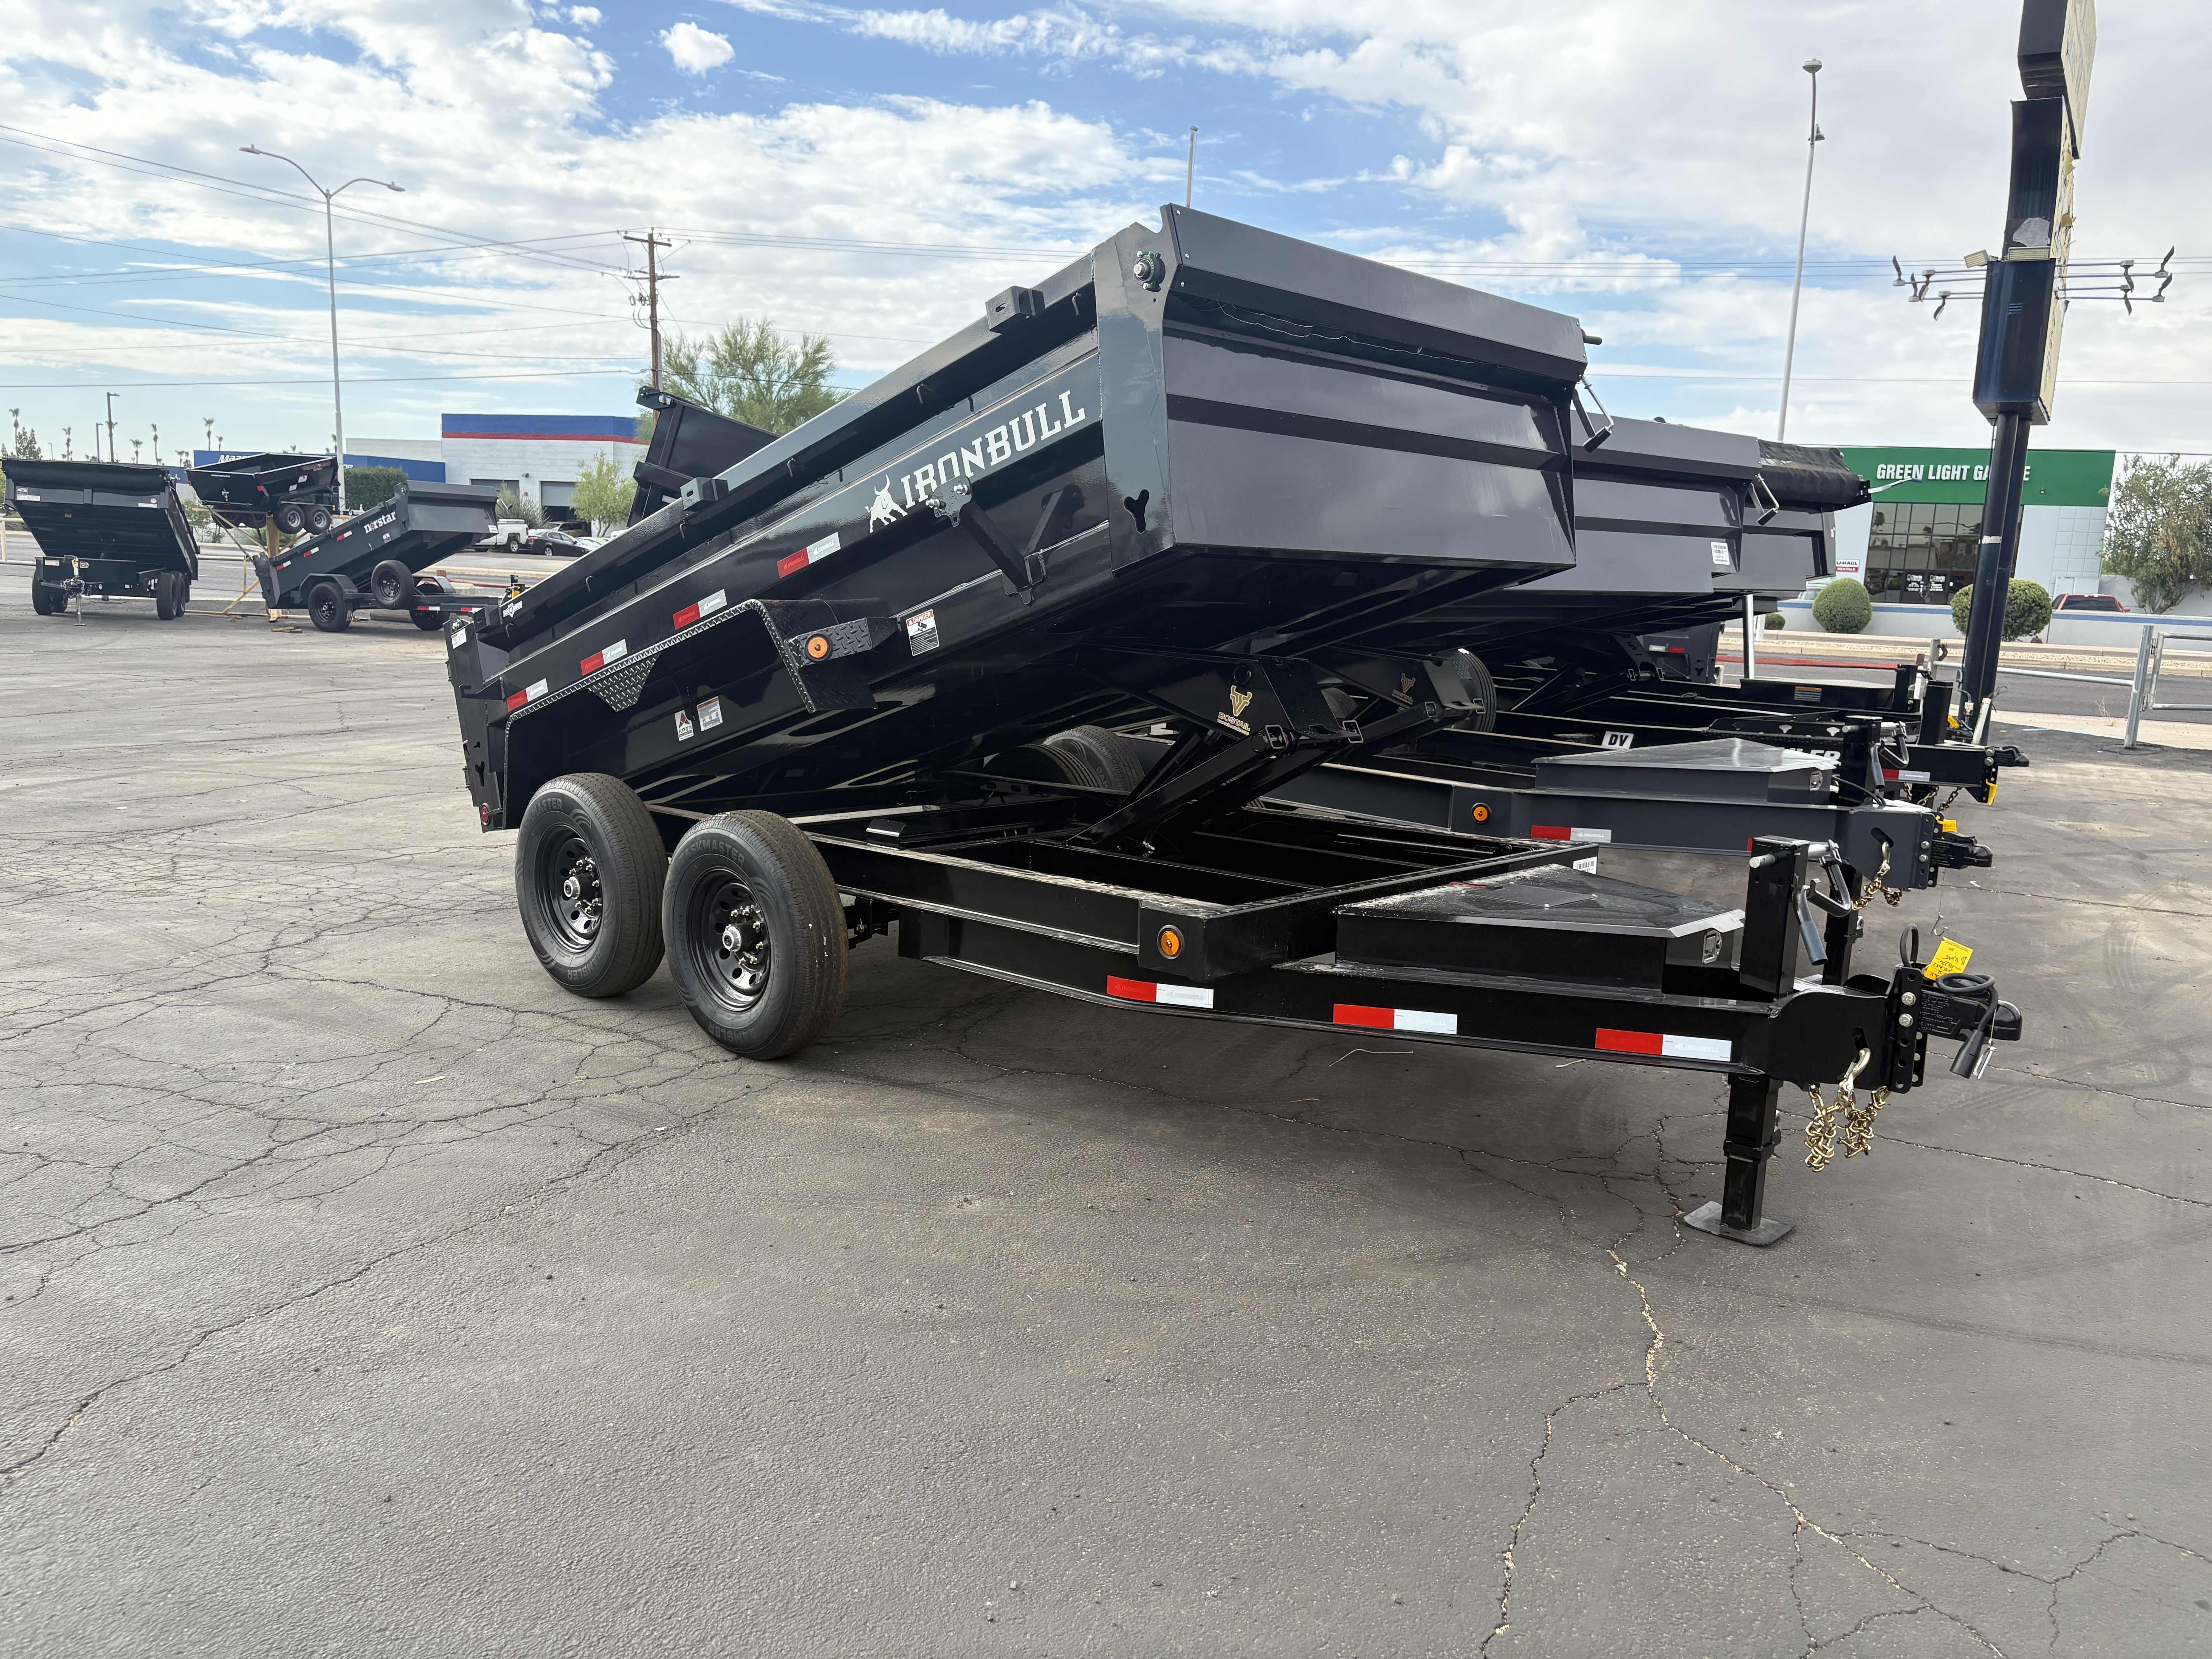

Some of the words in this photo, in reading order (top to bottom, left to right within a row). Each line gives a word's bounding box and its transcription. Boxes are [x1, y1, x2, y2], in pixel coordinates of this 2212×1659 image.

[901, 390, 1085, 510] IRONBULL
[1877, 464, 1924, 479] GREEN
[1928, 464, 1970, 480] LIGHT
[913, 612, 931, 623] DANGER
[678, 725, 692, 734] APEX
[1218, 711, 1251, 731] BOSTAIL
[1608, 734, 1629, 747] DV
[679, 839, 745, 867] TASKMASTER
[567, 948, 602, 981] RAMBLER
[708, 1020, 756, 1043] RAMBLER
